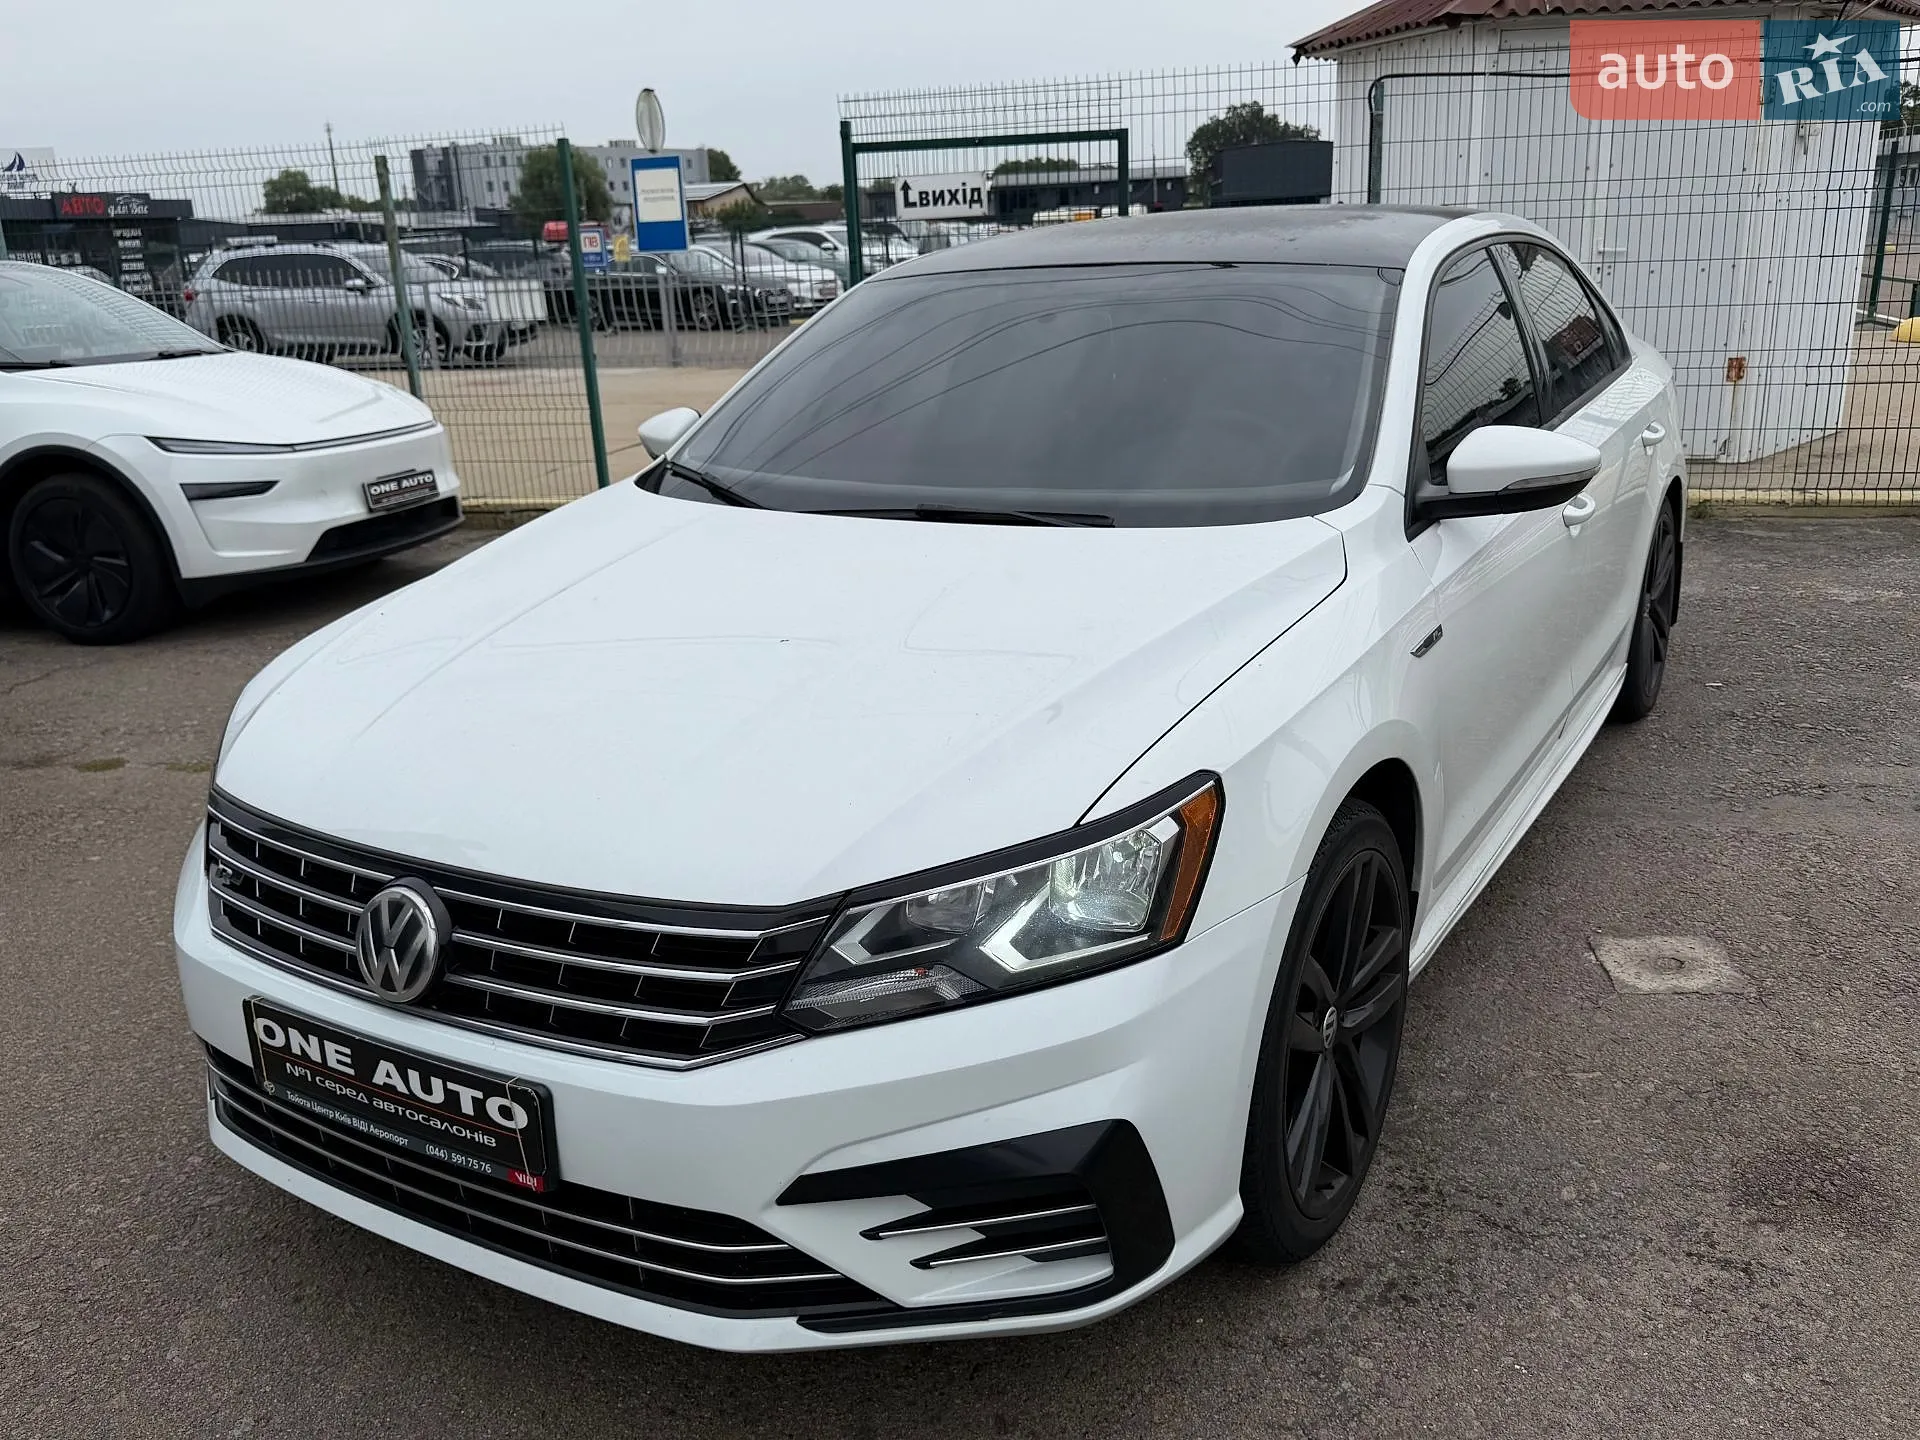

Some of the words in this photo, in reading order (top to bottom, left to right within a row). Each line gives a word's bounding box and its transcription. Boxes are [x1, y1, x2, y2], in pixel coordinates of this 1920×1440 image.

[62, 195, 105, 216] АВТО
[370, 481, 399, 495] ONE
[401, 474, 434, 489] AUTO
[253, 1017, 356, 1076] ONE
[372, 1059, 529, 1130] AUTO
[286, 1090, 311, 1108] Тойота
[311, 1101, 335, 1119] Центр
[369, 1123, 409, 1147] Аеропорт
[316, 1076, 370, 1105] серед
[372, 1097, 497, 1148] автосалонів
[425, 1143, 448, 1161] (044)
